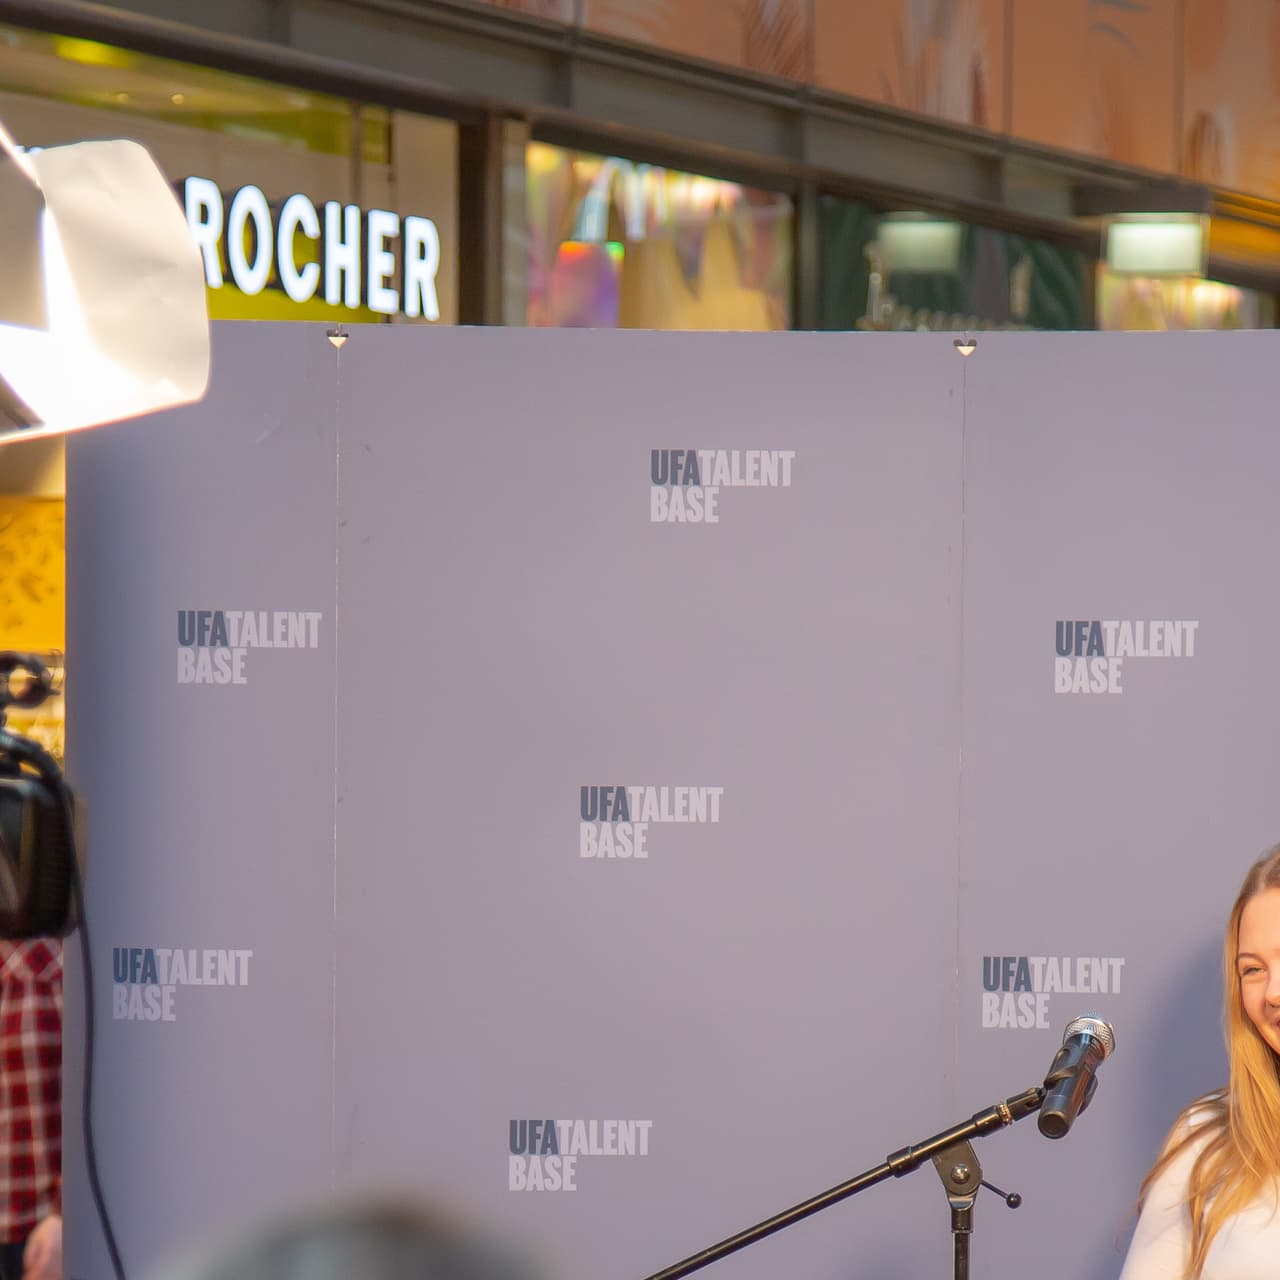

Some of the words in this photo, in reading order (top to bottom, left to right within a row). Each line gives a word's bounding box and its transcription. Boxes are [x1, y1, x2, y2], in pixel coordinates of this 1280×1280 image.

[184, 176, 440, 321] ROCHER
[650, 487, 719, 523] BASE
[177, 648, 248, 684] BASE
[1054, 657, 1123, 694] BASE
[579, 822, 648, 859] BASE
[112, 985, 176, 1022] BASE
[982, 993, 1050, 1030] BASE
[508, 1155, 577, 1192] BASE
